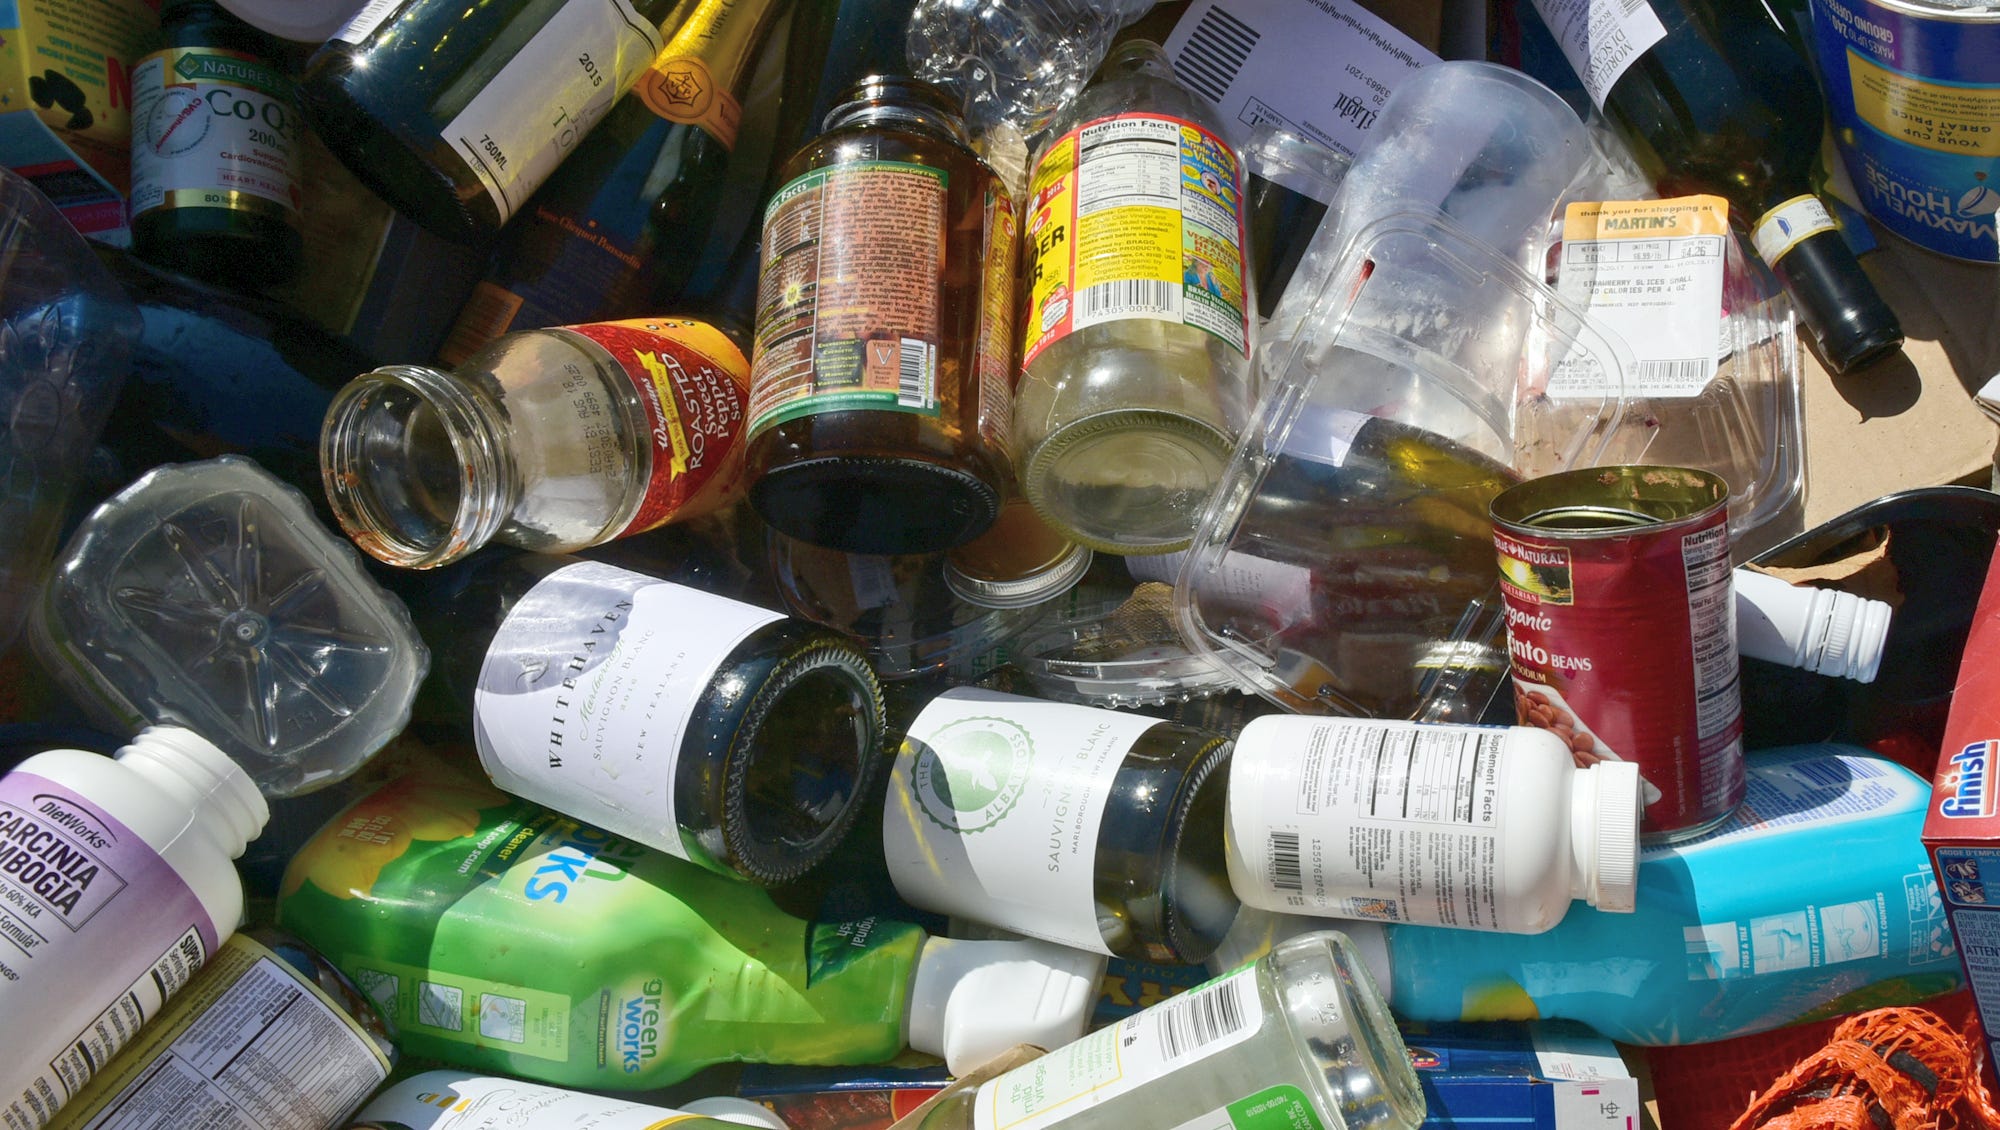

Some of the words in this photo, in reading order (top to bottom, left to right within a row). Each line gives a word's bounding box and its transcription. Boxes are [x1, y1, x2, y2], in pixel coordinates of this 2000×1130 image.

[1611, 28, 1627, 47] DI
[1831, 15, 1848, 40] 240
[1854, 15, 1894, 44] GROUND
[1859, 34, 1870, 46] UP
[1868, 38, 1895, 61] MAKES
[578, 52, 604, 88] 2015
[1344, 62, 1391, 98] 33663-1201
[205, 88, 255, 120] Co
[1081, 120, 1137, 139] Nutrition
[1141, 120, 1177, 131] Facts
[1264, 109, 1284, 126] TAMPA
[1891, 108, 1933, 126] PRICE
[1939, 122, 1992, 134] GREAT
[248, 128, 276, 148] 200
[1904, 128, 1931, 140] CUP
[1937, 129, 1953, 137] AT
[1937, 137, 1981, 148] YOUR
[479, 134, 508, 172] 750ML
[222, 173, 256, 185] HEART
[1864, 162, 1952, 216] HOUSE
[203, 193, 219, 202] 80
[781, 183, 808, 202] Facts
[1580, 209, 1609, 217] thank
[1611, 207, 1631, 217] you
[1633, 206, 1648, 214] for
[1651, 205, 1699, 214] shopping
[1868, 178, 1998, 241] MAXWELL
[1604, 215, 1678, 231] MARTIN'S
[598, 233, 643, 271] Ponsardin
[1096, 248, 1118, 256] FOOD
[1121, 258, 1152, 266] Organic
[1092, 271, 1130, 283] PRODUCT
[1583, 278, 1632, 288] STRAWBERRY
[1635, 278, 1665, 286] SLICES
[1604, 286, 1643, 295] CALORIES
[1128, 305, 1163, 314] 00132
[872, 341, 896, 349] VEGAN
[660, 352, 704, 470] ROASTED
[693, 374, 717, 436] Sweet
[700, 366, 729, 440] Pepper
[723, 378, 741, 421] Salsa
[640, 376, 669, 451] Wegmans
[588, 446, 602, 474] BEST
[1684, 527, 1725, 548] Nutrition
[1516, 543, 1565, 566] NATURAL
[1502, 583, 1538, 603] GETARIAN
[1518, 664, 1546, 683] SODIUM
[1550, 654, 1593, 672] BEANS
[548, 598, 633, 770] WHITEHAVEN
[592, 671, 623, 761] SAUVIGNON
[621, 628, 655, 672] BLANC
[635, 728, 648, 762] NEW
[645, 650, 687, 721] ZEALAND
[1075, 720, 1112, 760] BLANC
[1484, 733, 1503, 786] Supplement
[919, 760, 930, 791] THE
[1943, 740, 1987, 818] finish
[1482, 789, 1496, 822] Facts
[38, 801, 107, 850] DietWorks
[1072, 786, 1091, 853] MARLBOROUGH
[0, 810, 100, 892] GARCINIA
[476, 830, 499, 851] soap
[497, 827, 535, 861] cleaner
[458, 849, 482, 875] scum
[0, 839, 83, 917] MBOGIA
[5, 888, 24, 909] 60%
[22, 899, 43, 920] HCA
[1955, 911, 1978, 922] TENIR
[1740, 926, 1748, 942] TILE
[640, 977, 664, 1059] green
[623, 996, 644, 1074] works
[1010, 1081, 1022, 1105] the
[1033, 1062, 1047, 1104] vinegar
[1022, 1085, 1035, 1115] mild
